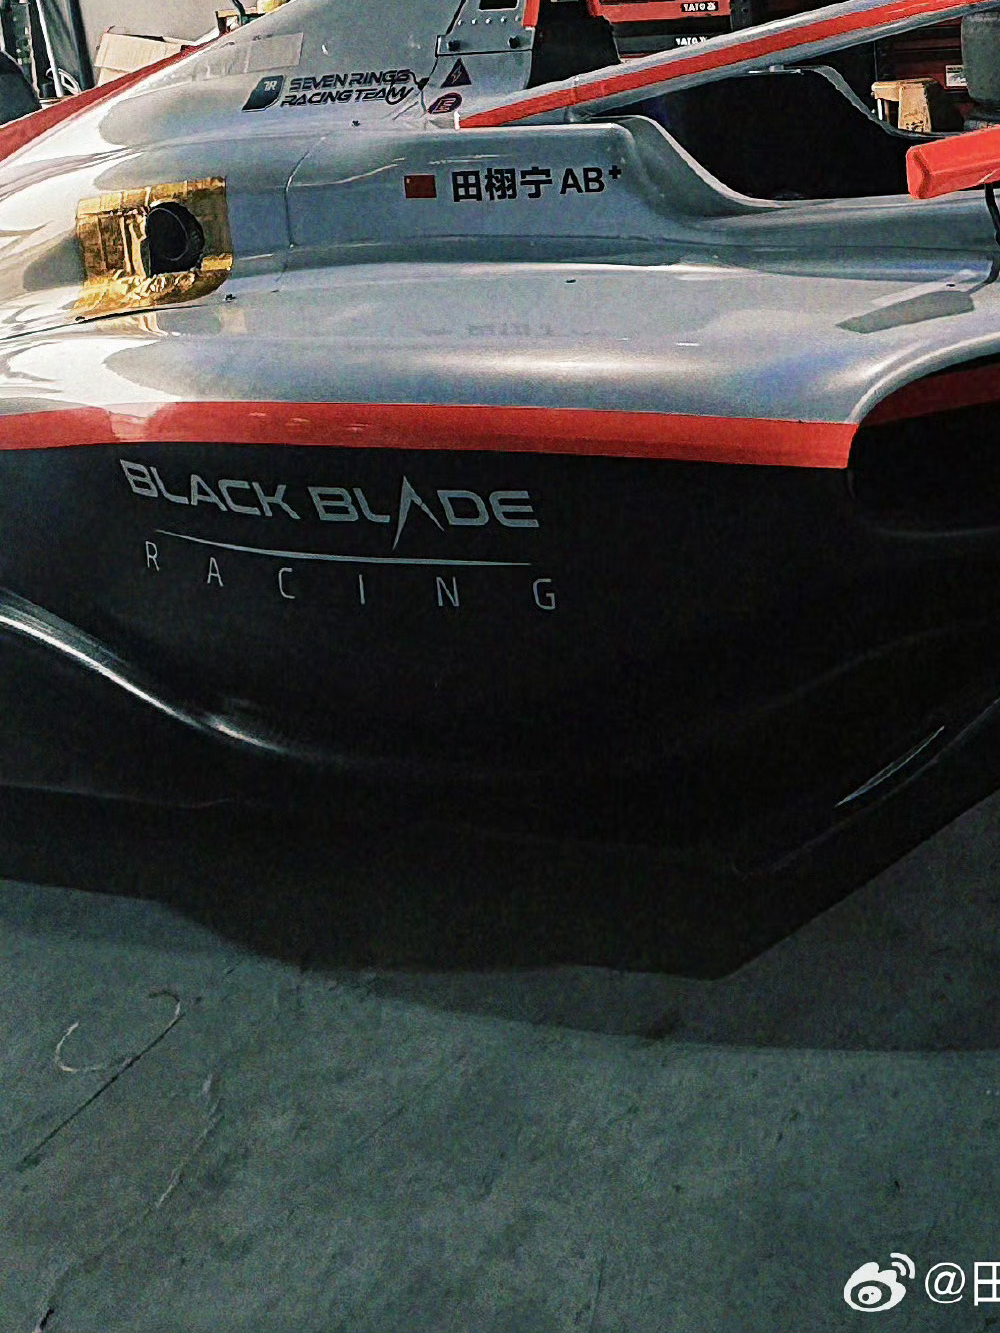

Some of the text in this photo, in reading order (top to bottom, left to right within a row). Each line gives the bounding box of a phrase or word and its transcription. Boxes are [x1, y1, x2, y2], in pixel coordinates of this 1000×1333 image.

[683, 2, 706, 12] YATO
[675, 37, 699, 46] YATO
[289, 69, 411, 93] SEVEN RINGS
[280, 85, 414, 107] RACING TEAM
[451, 166, 553, 203] 田栩宁
[119, 458, 541, 551] BLACK BLADE
[144, 539, 557, 611] RACING
